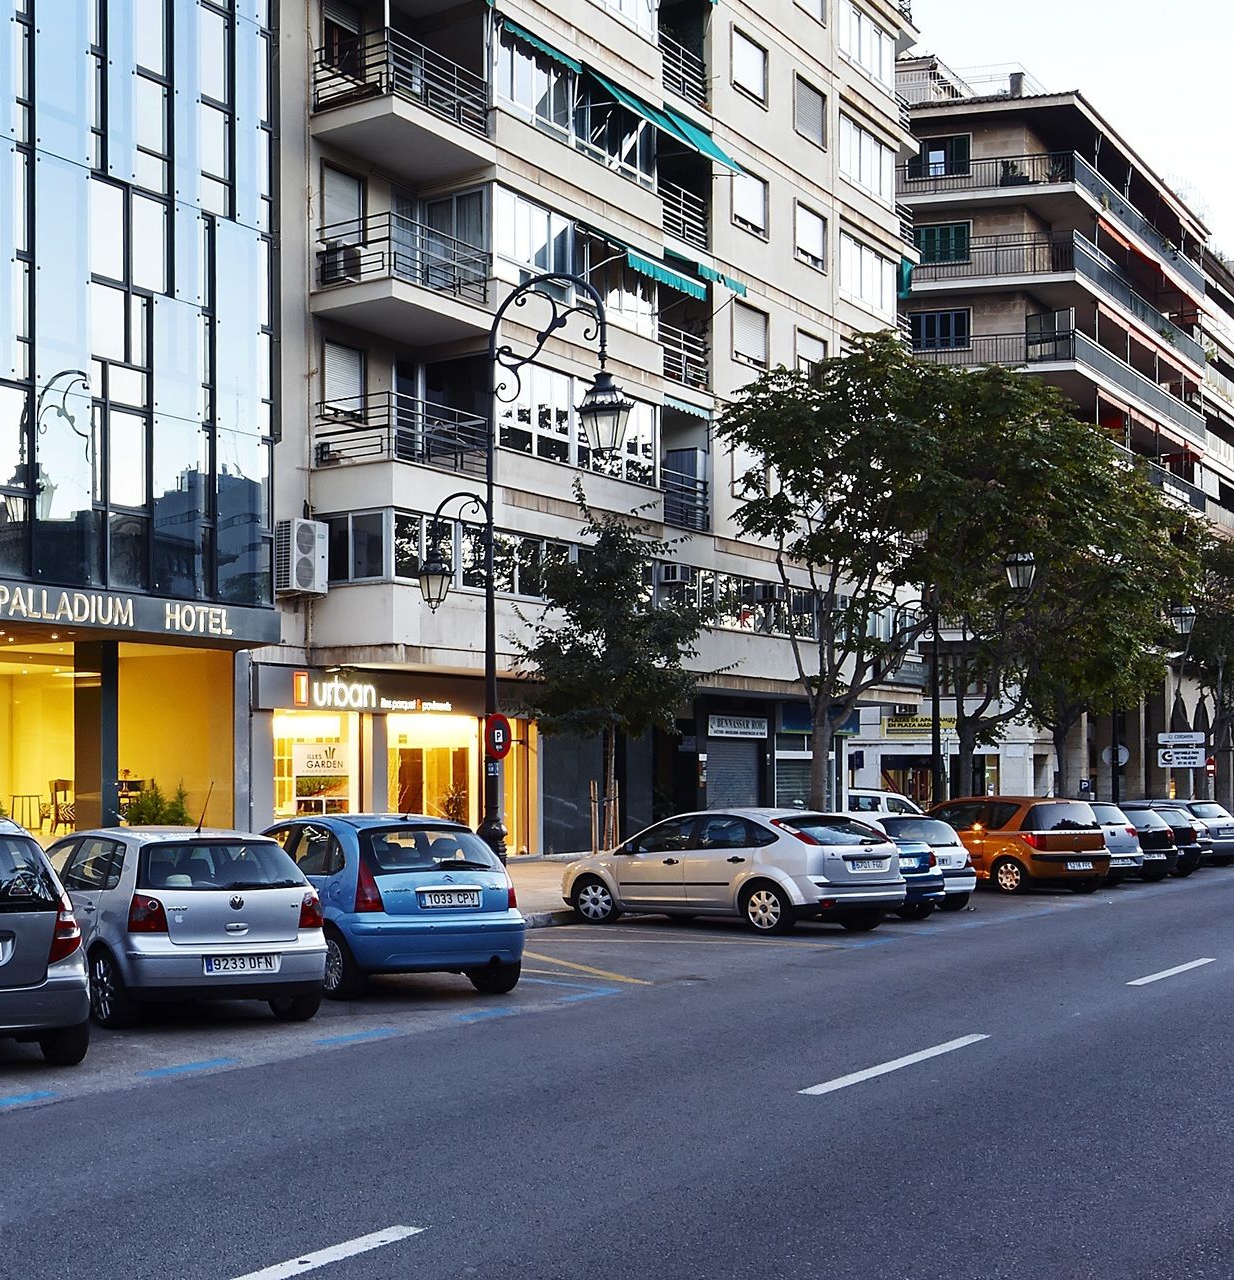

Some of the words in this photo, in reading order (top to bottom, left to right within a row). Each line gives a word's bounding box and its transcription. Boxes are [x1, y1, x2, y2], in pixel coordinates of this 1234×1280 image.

[165, 603, 234, 636] HOTEL
[313, 675, 377, 709] urban
[496, 731, 502, 741] P
[306, 760, 344, 769] GARDEN
[1081, 781, 1089, 790] P
[428, 893, 453, 905] 1033
[457, 892, 475, 904] CPV
[214, 957, 246, 970] 9233
[249, 956, 273, 969] DFN
